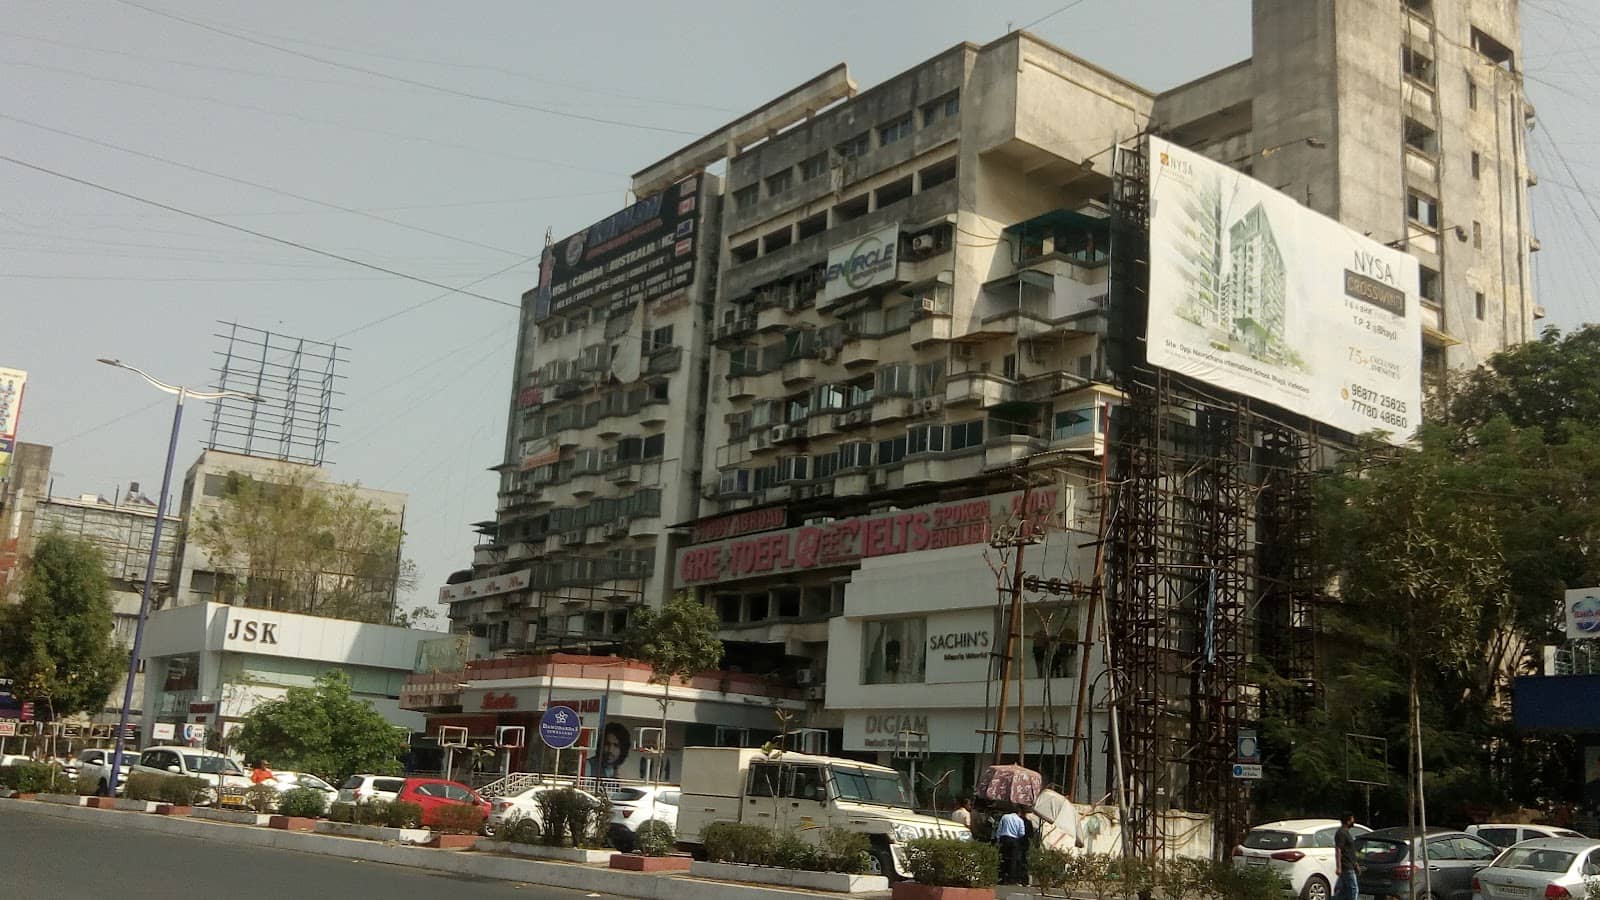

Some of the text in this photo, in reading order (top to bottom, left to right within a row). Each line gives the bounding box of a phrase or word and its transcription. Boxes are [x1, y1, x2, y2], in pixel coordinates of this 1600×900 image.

[1171, 156, 1193, 177] NYSA
[1353, 251, 1394, 284] NYSA
[1352, 384, 1407, 414] 96877 25625
[1352, 400, 1378, 420] 77780
[932, 500, 991, 526] SPOKEN
[680, 546, 722, 584] GRE
[727, 534, 796, 577] TOEFL
[862, 511, 931, 559] IELTS
[227, 618, 278, 645] JSK
[930, 631, 989, 651] SACHIN'S
